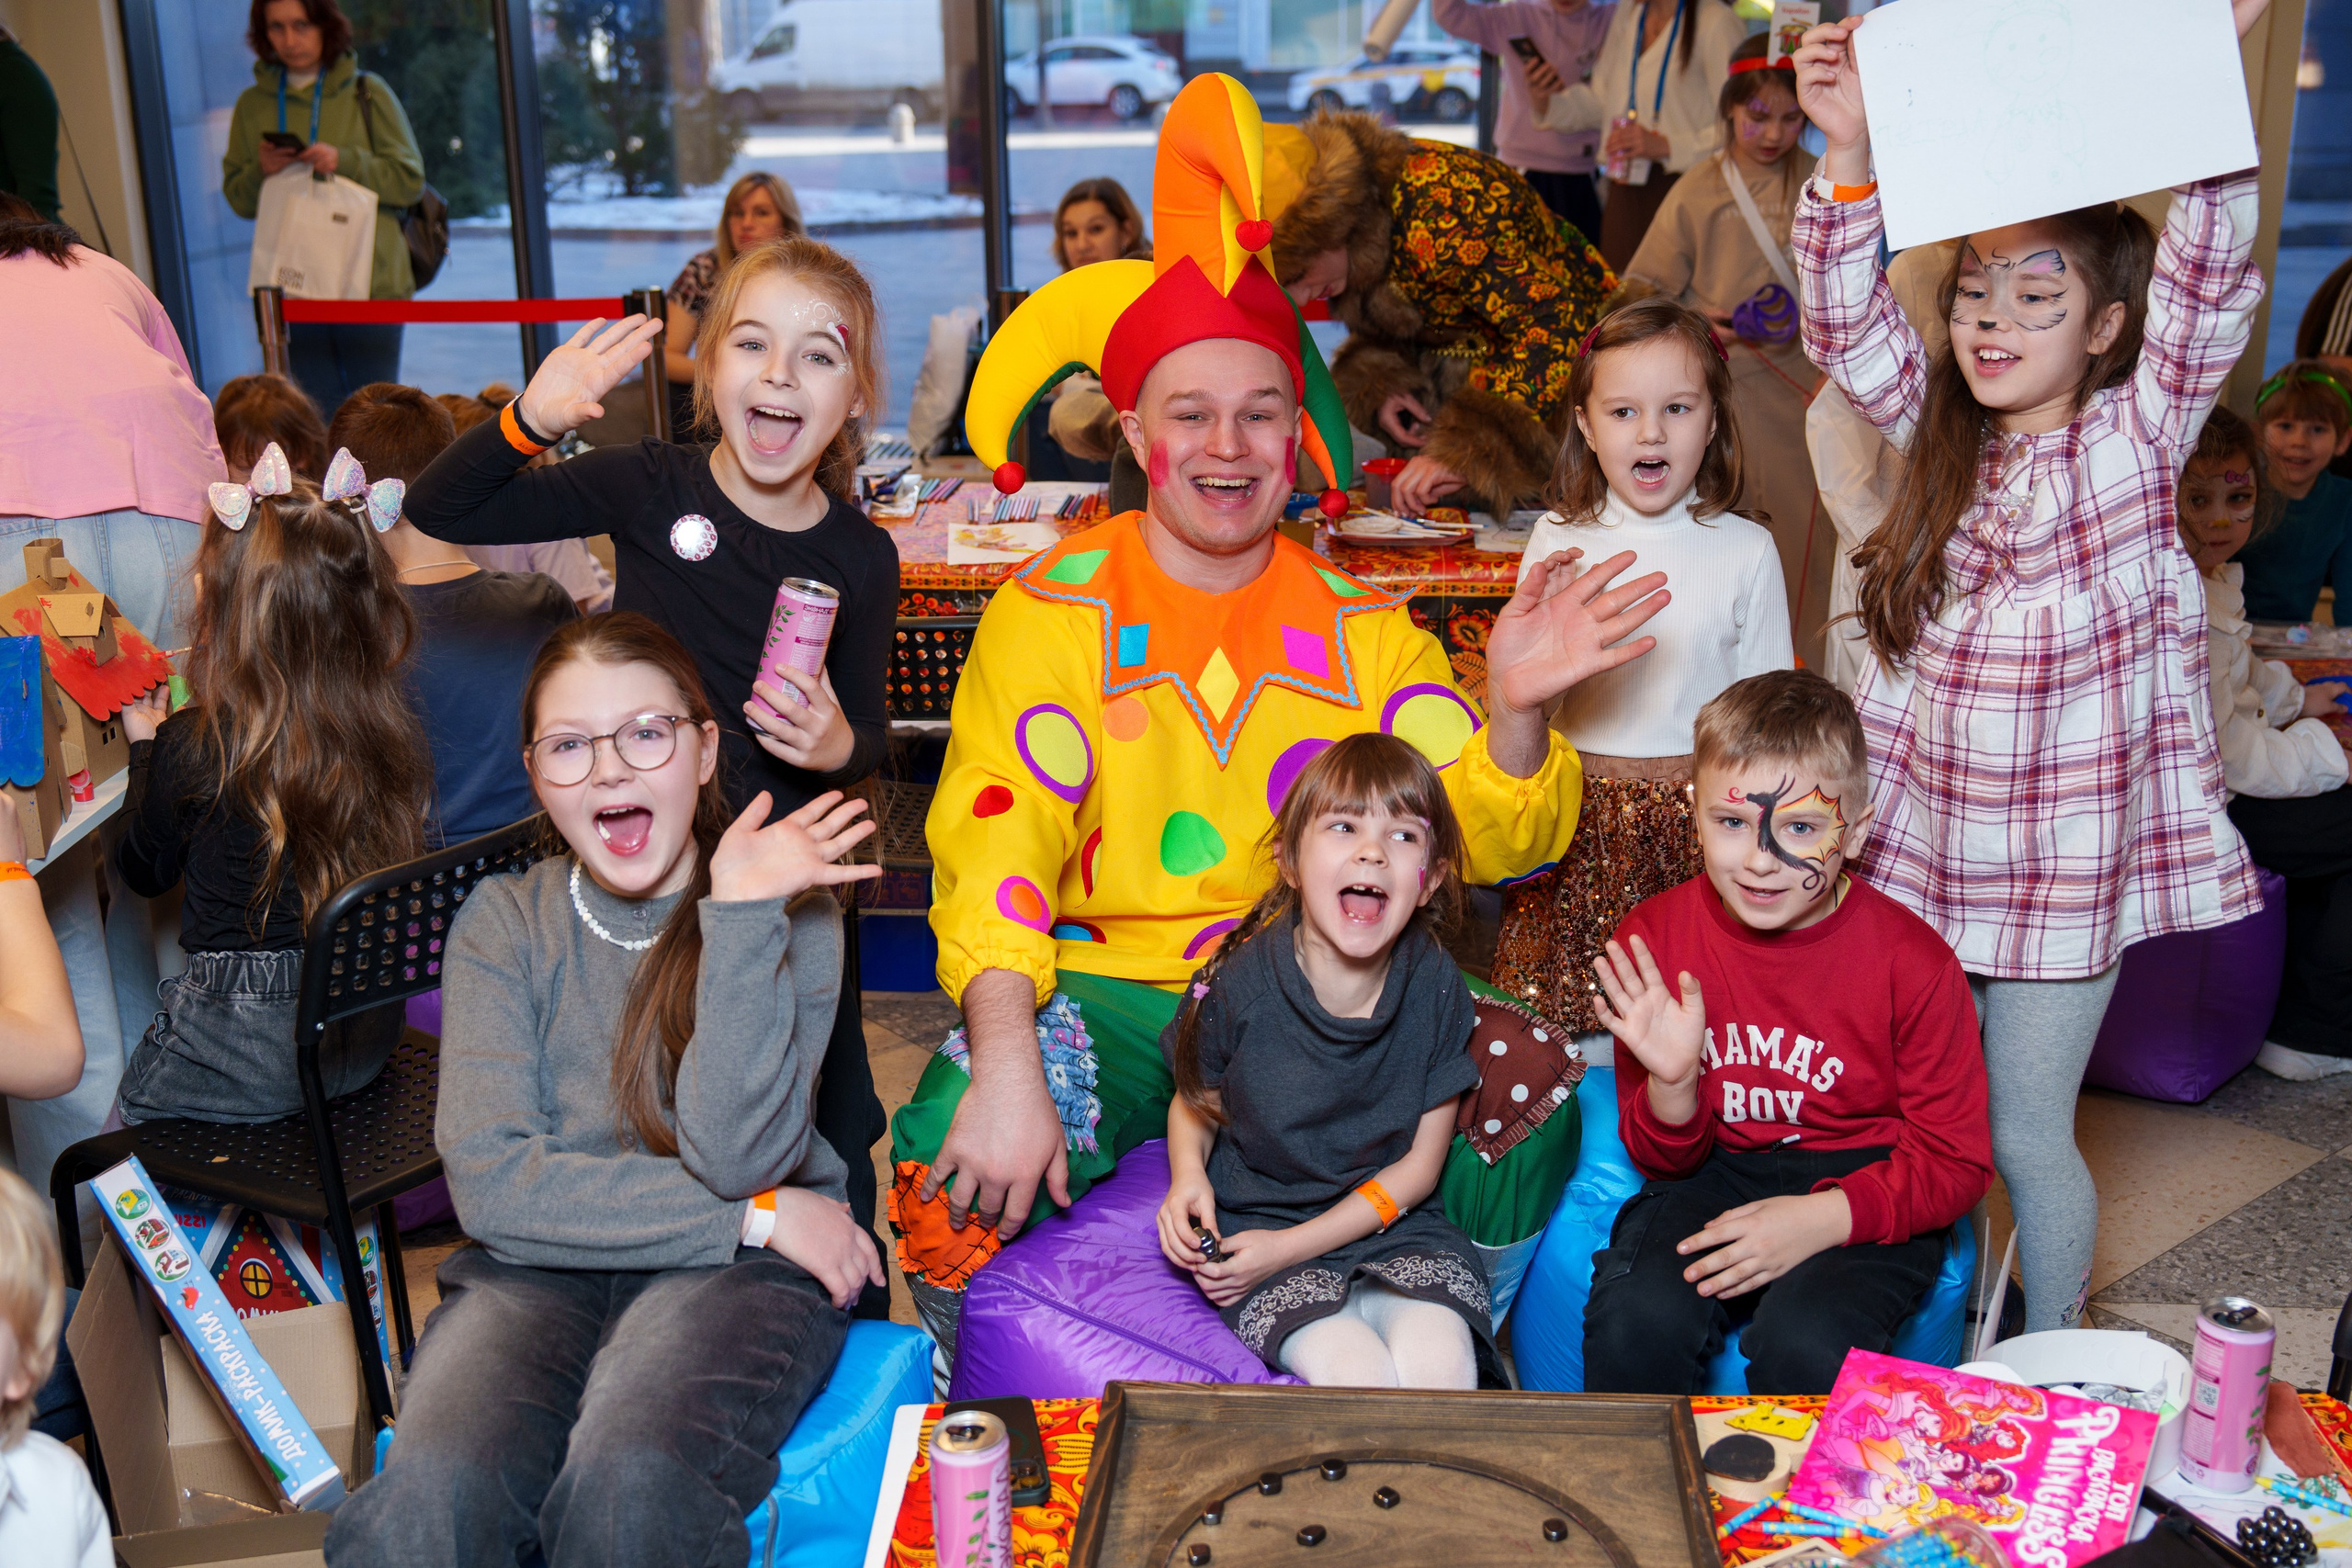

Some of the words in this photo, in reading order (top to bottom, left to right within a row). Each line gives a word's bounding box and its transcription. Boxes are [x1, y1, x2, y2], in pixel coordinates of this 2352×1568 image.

[1723, 1080, 1804, 1125] BOY
[175, 1213, 206, 1229] UZZI
[196, 1310, 307, 1461] ДОМИК-РАСКРАСКА
[2015, 1406, 2120, 1568] PRINCESS
[2067, 1448, 2116, 1543] РАСКРАСКА
[2104, 1481, 2134, 1522] ТОП
